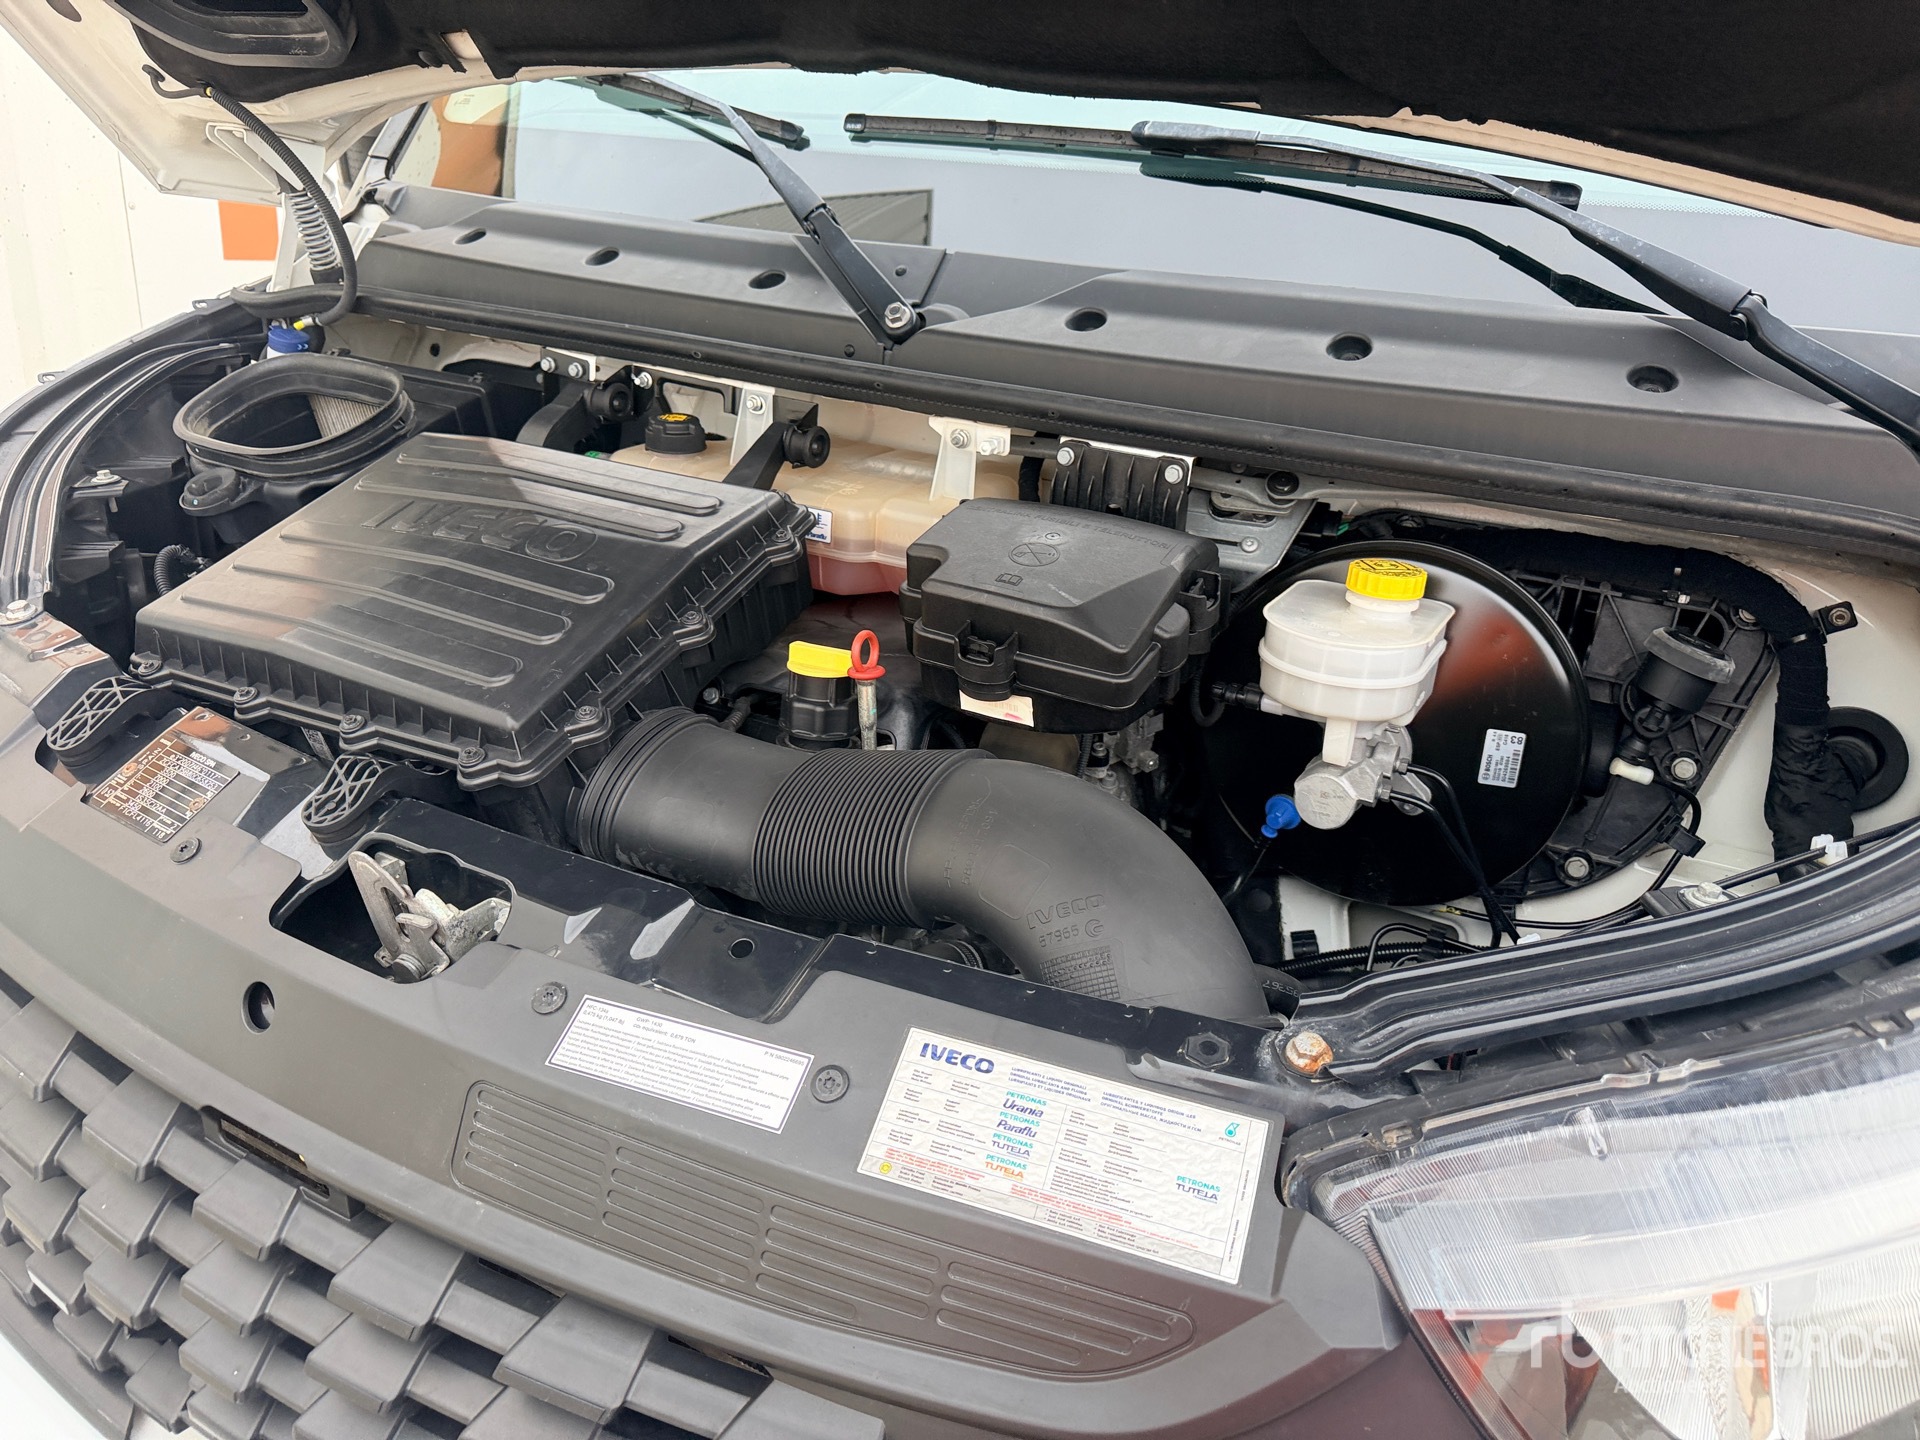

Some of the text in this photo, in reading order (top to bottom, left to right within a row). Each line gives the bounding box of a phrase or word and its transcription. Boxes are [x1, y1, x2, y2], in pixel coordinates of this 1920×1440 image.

[360, 500, 597, 561] IVECO
[1484, 754, 1493, 771] BOSCH
[1026, 894, 1105, 930] IVECO
[1039, 925, 1080, 948] 57965
[918, 1041, 996, 1076] IVECO
[1005, 1090, 1047, 1106] PETRONAS
[1002, 1097, 1045, 1118] Urania
[999, 1110, 1040, 1127] PETRONAS
[996, 1118, 1038, 1138] Paraflu
[990, 1139, 1031, 1156] TUTELA
[992, 1132, 1034, 1149] PETRONAS
[983, 1161, 1024, 1178] TUTELA
[985, 1153, 1027, 1170] PETRONAS
[1174, 1182, 1218, 1200] TUTELA
[1176, 1174, 1221, 1192] PETRONAS
